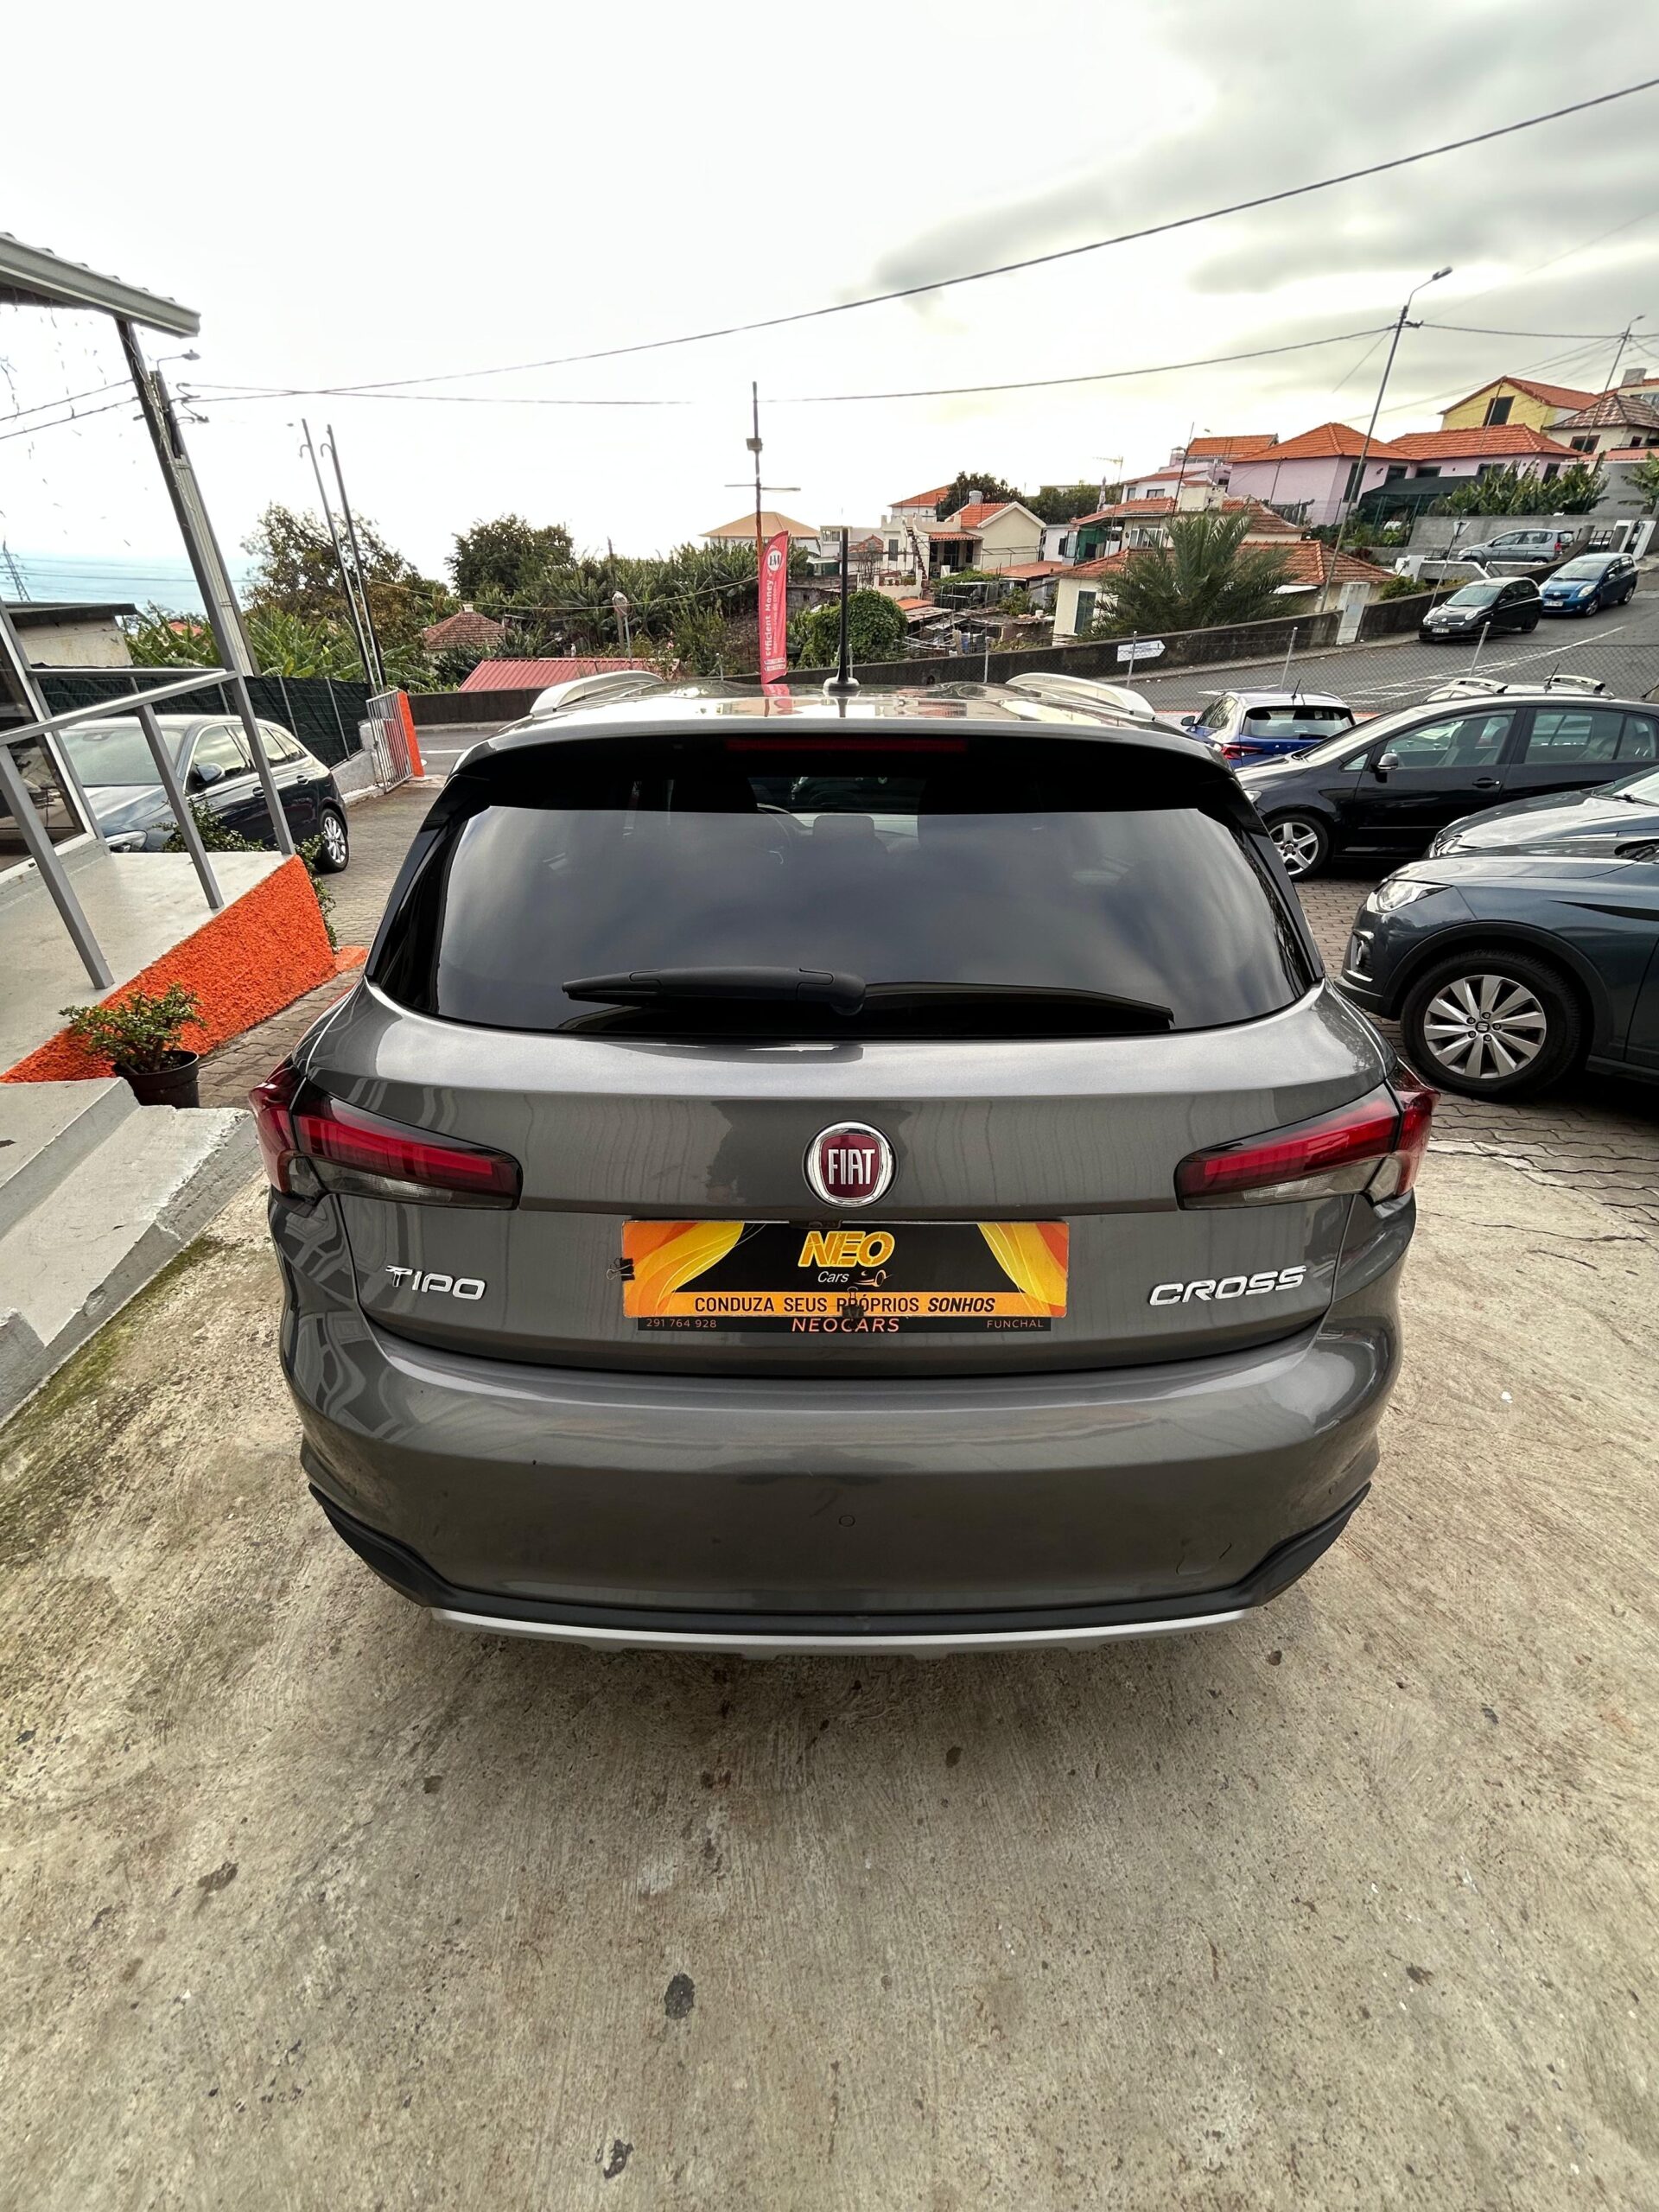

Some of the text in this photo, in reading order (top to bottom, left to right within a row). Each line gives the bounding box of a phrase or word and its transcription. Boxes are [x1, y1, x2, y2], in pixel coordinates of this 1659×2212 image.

[828, 1148, 875, 1185] FIAT
[798, 1230, 895, 1268] NEO
[385, 1264, 486, 1300] TIPO
[817, 1270, 849, 1283] Cars
[1147, 1264, 1307, 1306] CROSS
[695, 1297, 774, 1312] CONDUZA
[784, 1297, 827, 1312] SEUS
[927, 1297, 995, 1313] SONHOS
[646, 1319, 717, 1329] 291 764 928
[791, 1318, 899, 1332] NEOCARS
[987, 1319, 1045, 1329] FUNCHAL
